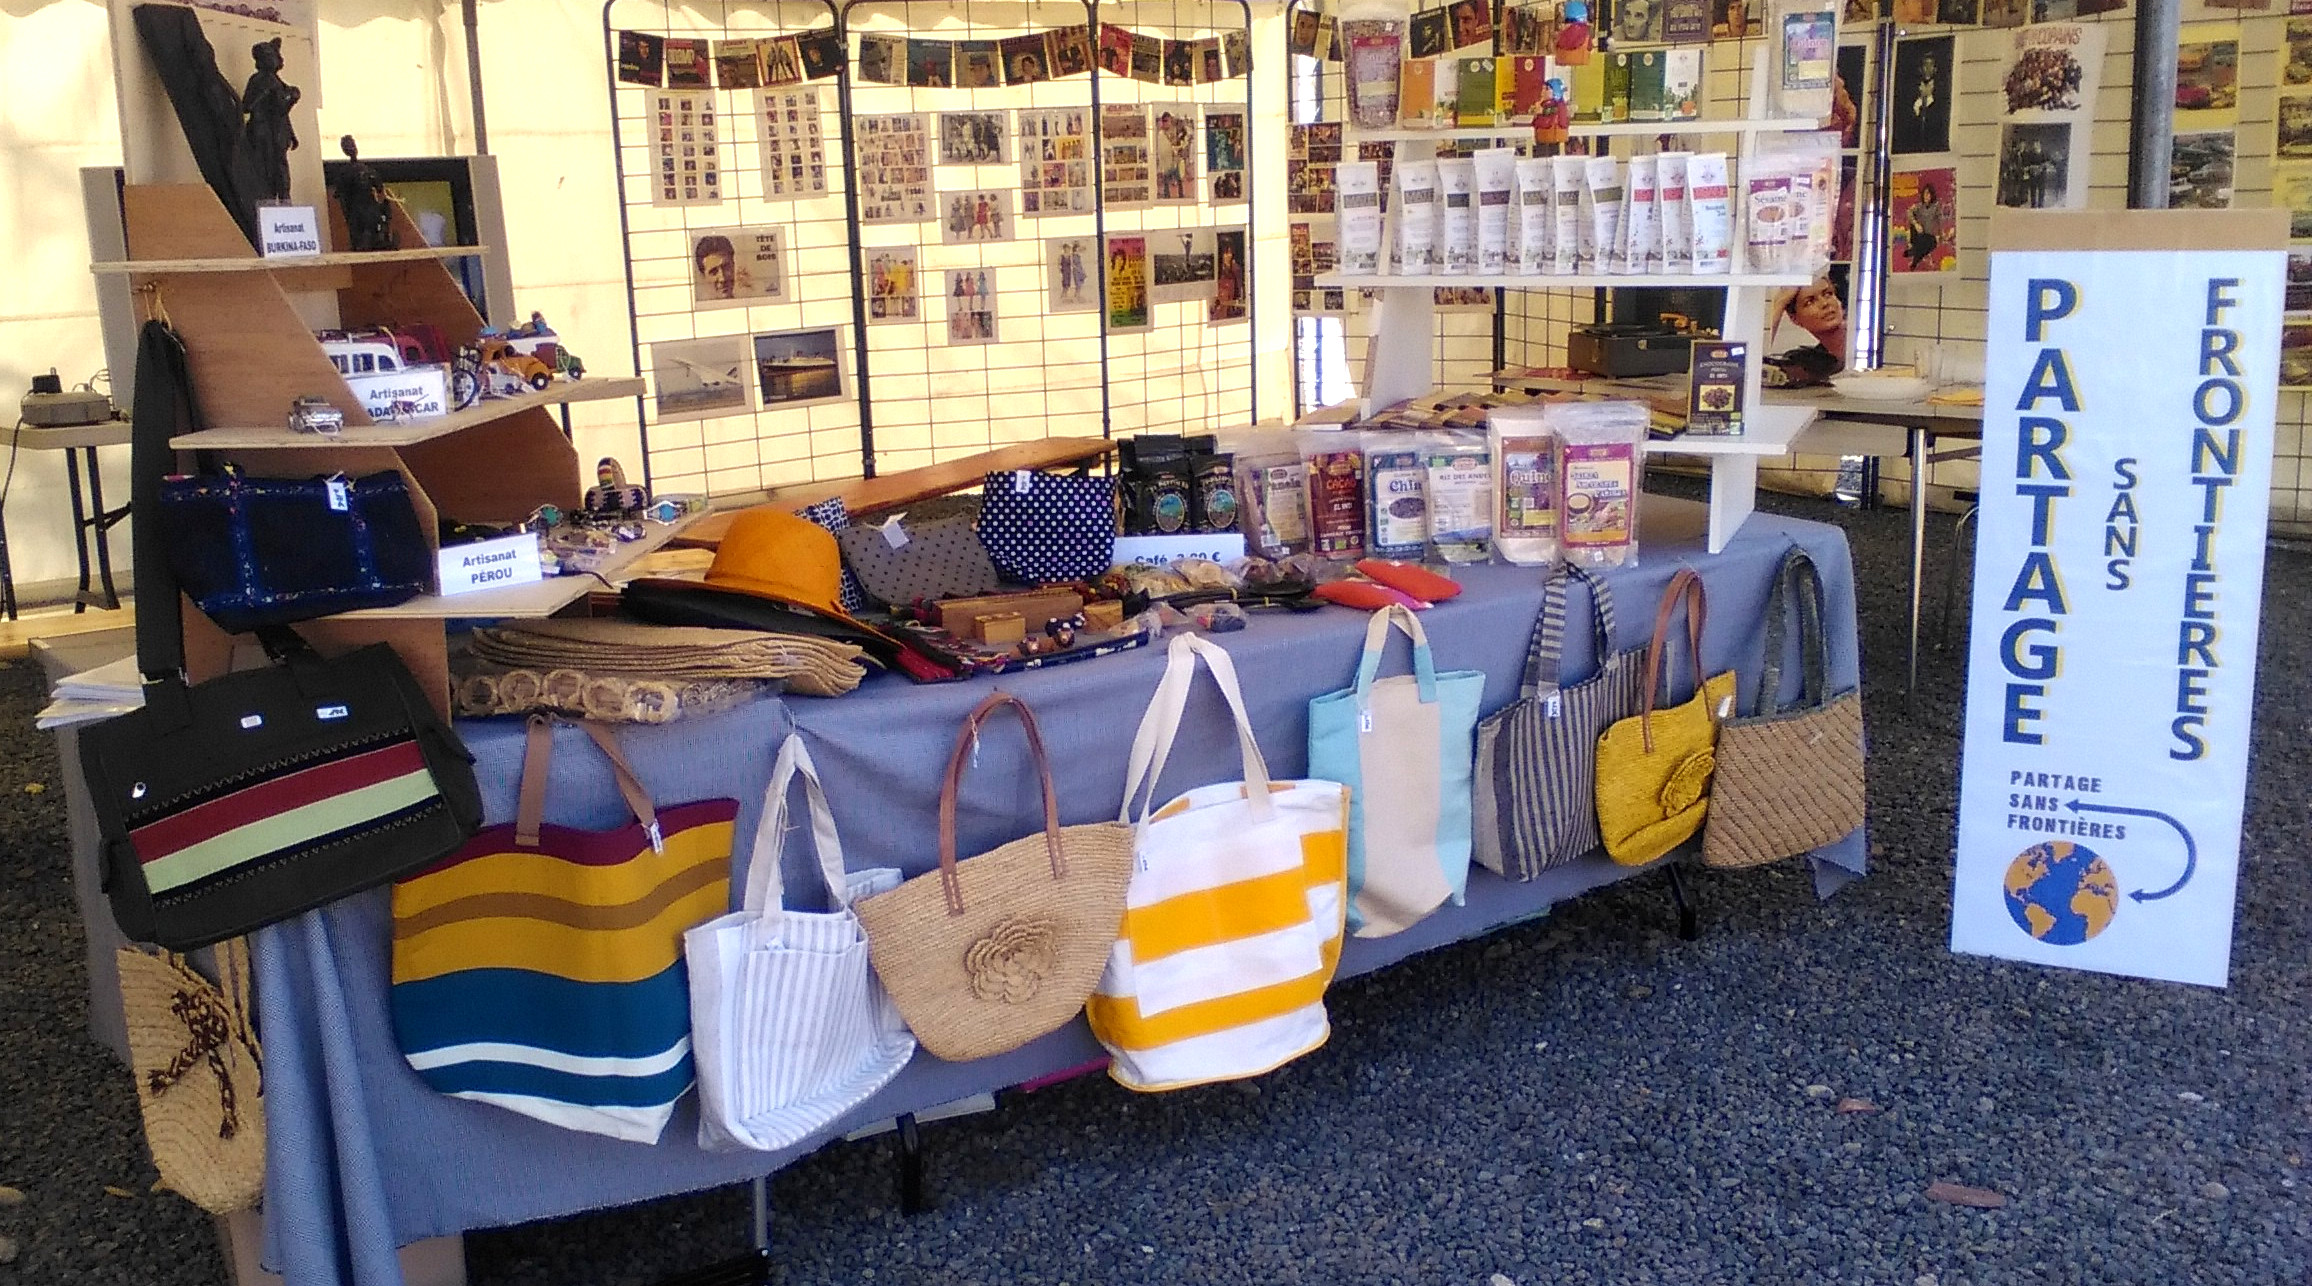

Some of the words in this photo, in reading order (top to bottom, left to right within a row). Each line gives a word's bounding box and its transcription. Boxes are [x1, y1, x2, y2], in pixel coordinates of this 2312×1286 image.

[274, 222, 305, 233] Artisanat
[267, 240, 316, 253] BURKINA-FASO
[370, 386, 423, 400] Artisanat
[1999, 277, 2084, 747] PARTAGE
[2168, 277, 2248, 762] FRONTIERES
[2105, 457, 2139, 591] SANS
[463, 549, 517, 567] Artisanat
[1135, 554, 1168, 566] Café
[471, 568, 512, 584] PÉROU
[2010, 770, 2102, 793] PARTAGE
[2009, 793, 2058, 811] SANS
[2007, 813, 2126, 840] FRONTIÈRES
